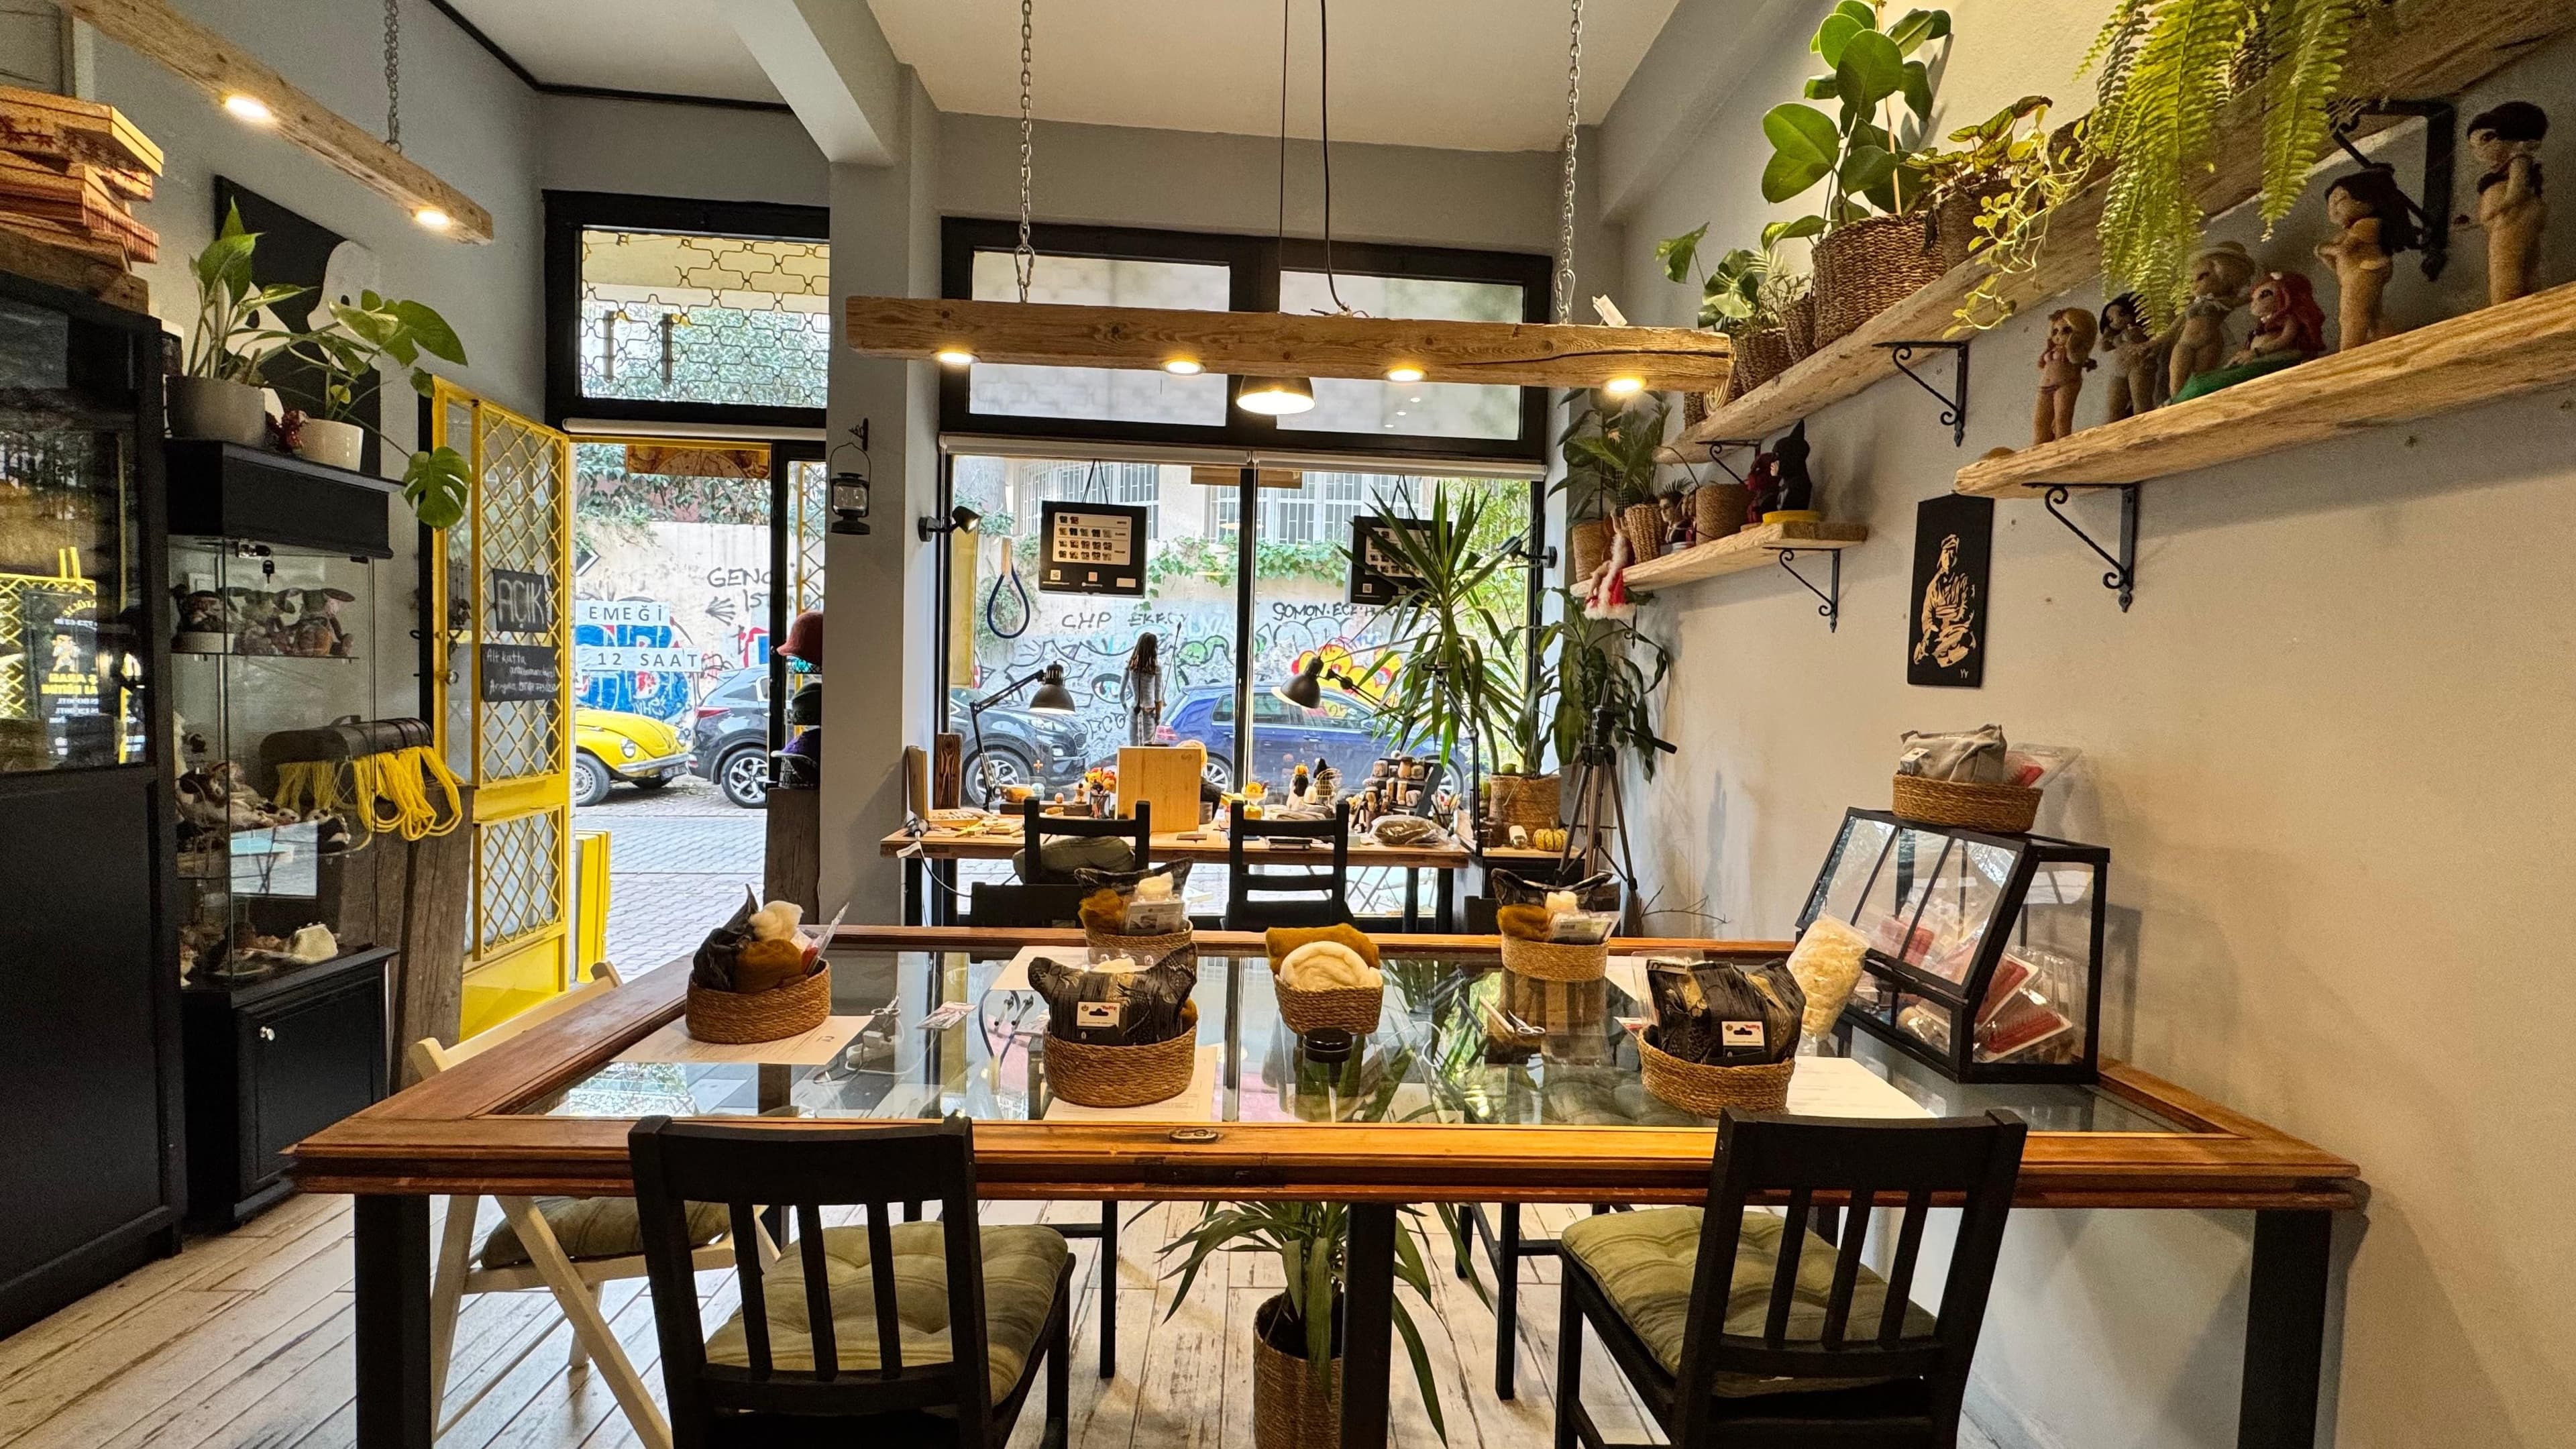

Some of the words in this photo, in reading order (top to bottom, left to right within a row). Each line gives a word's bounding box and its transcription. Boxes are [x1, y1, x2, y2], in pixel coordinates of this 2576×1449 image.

[589, 604, 662, 621] EMEĞİ
[1062, 611, 1112, 629] CHP
[597, 652, 622, 665] 12
[640, 653, 698, 667] SAAT
